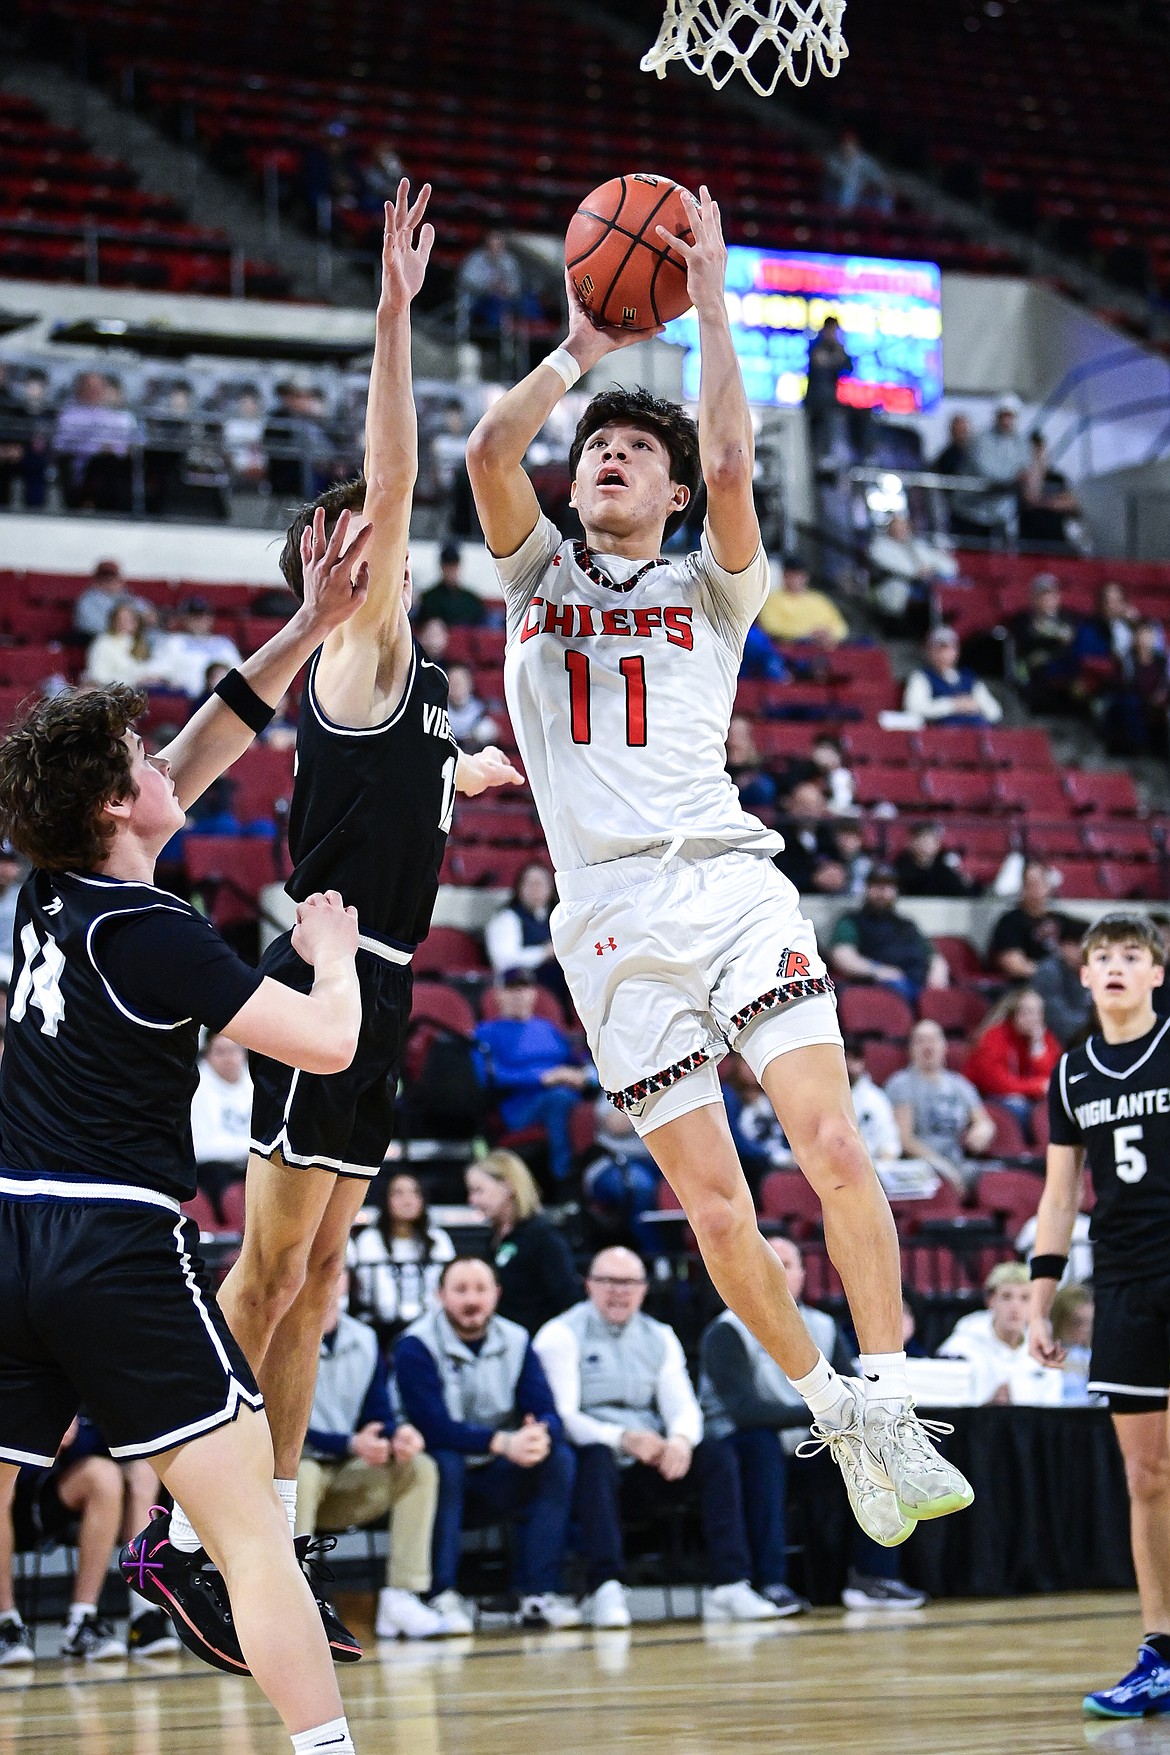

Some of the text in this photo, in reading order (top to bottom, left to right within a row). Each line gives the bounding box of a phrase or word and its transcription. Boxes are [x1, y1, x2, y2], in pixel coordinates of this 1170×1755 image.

[521, 597, 694, 651] CHIEFS
[565, 649, 647, 747] 11
[10, 918, 66, 1038] 14
[785, 951, 811, 978] R
[1074, 1087, 1170, 1130] VIGILANTE
[1113, 1124, 1148, 1184] 5
